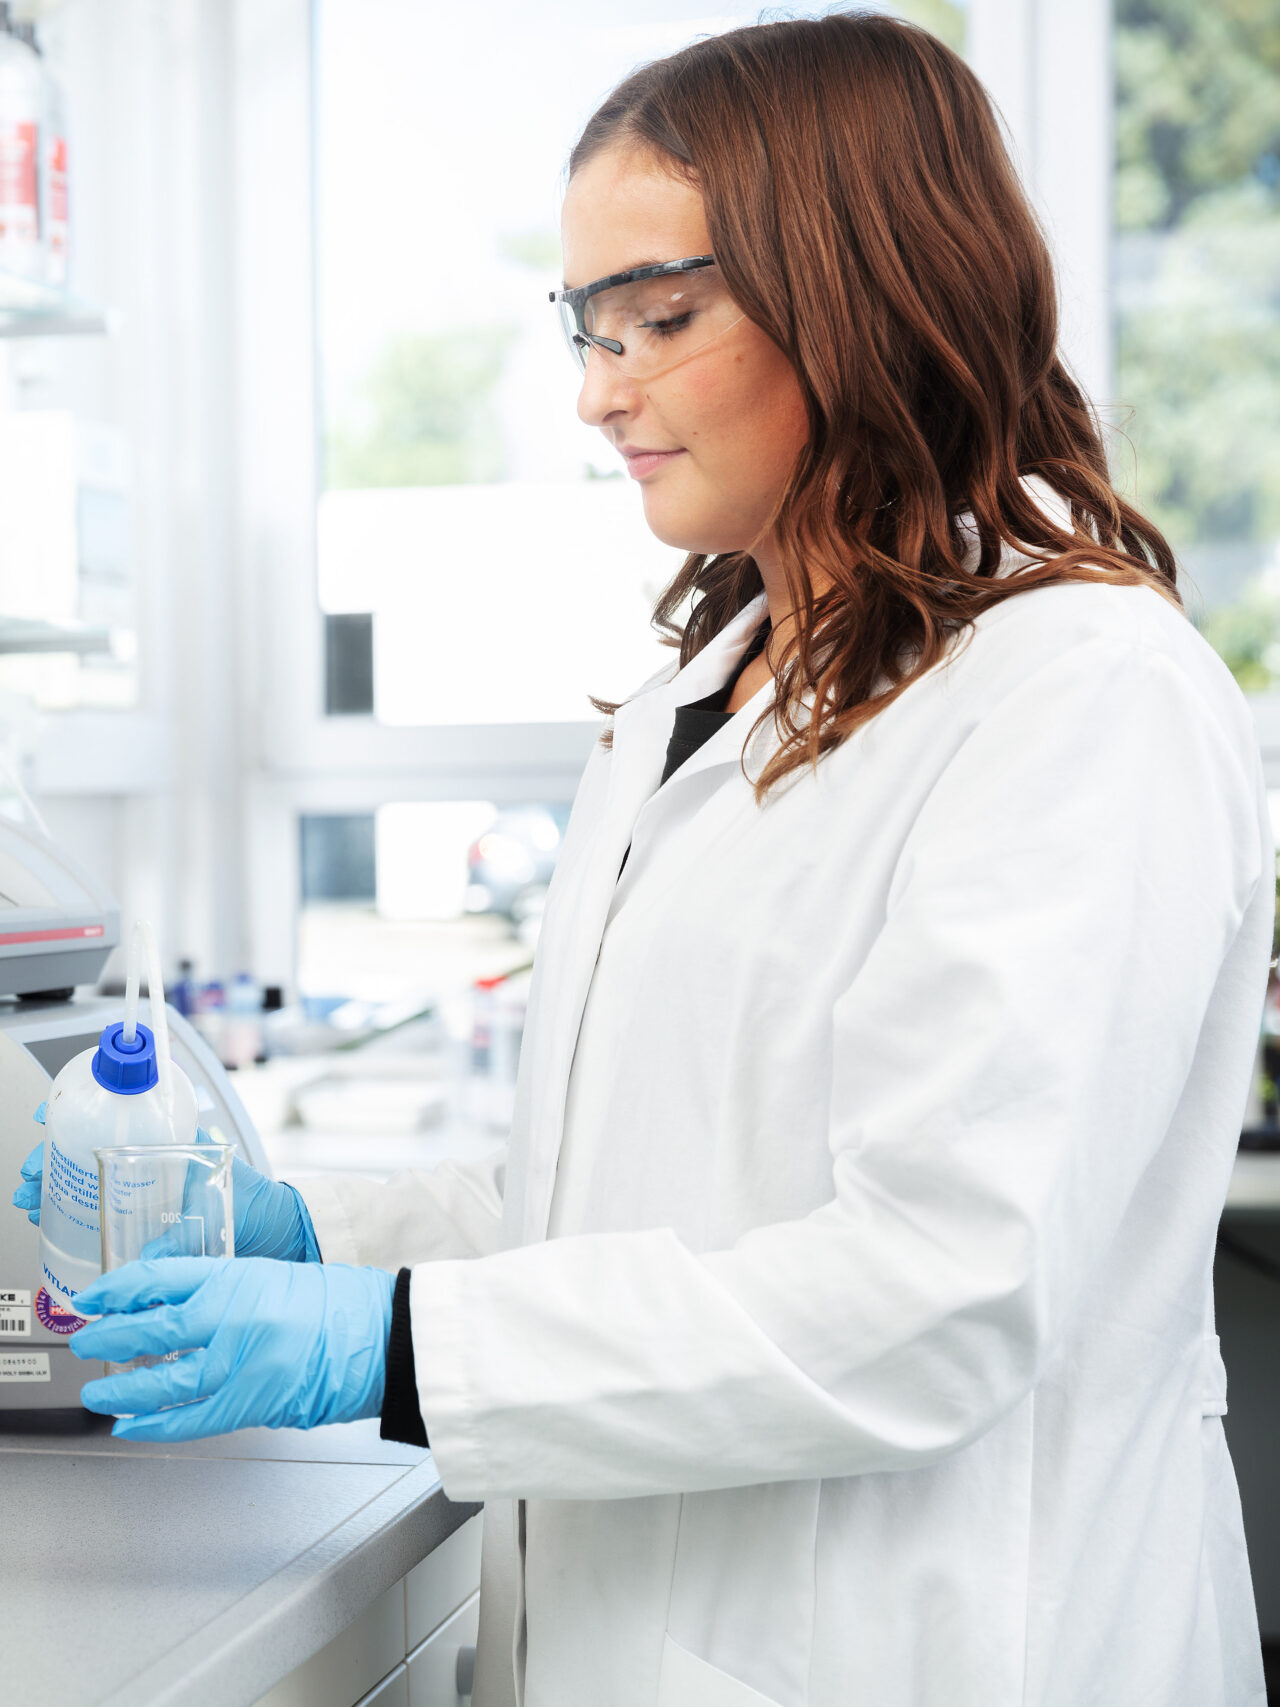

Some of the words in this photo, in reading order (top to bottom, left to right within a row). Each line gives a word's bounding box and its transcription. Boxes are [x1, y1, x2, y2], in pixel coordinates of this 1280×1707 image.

[50, 1152, 84, 1186] Distilled
[50, 1160, 62, 1180] Eau
[50, 1172, 69, 1196] Agua
[72, 1194, 98, 1210] desti
[123, 1180, 156, 1188] Wasser
